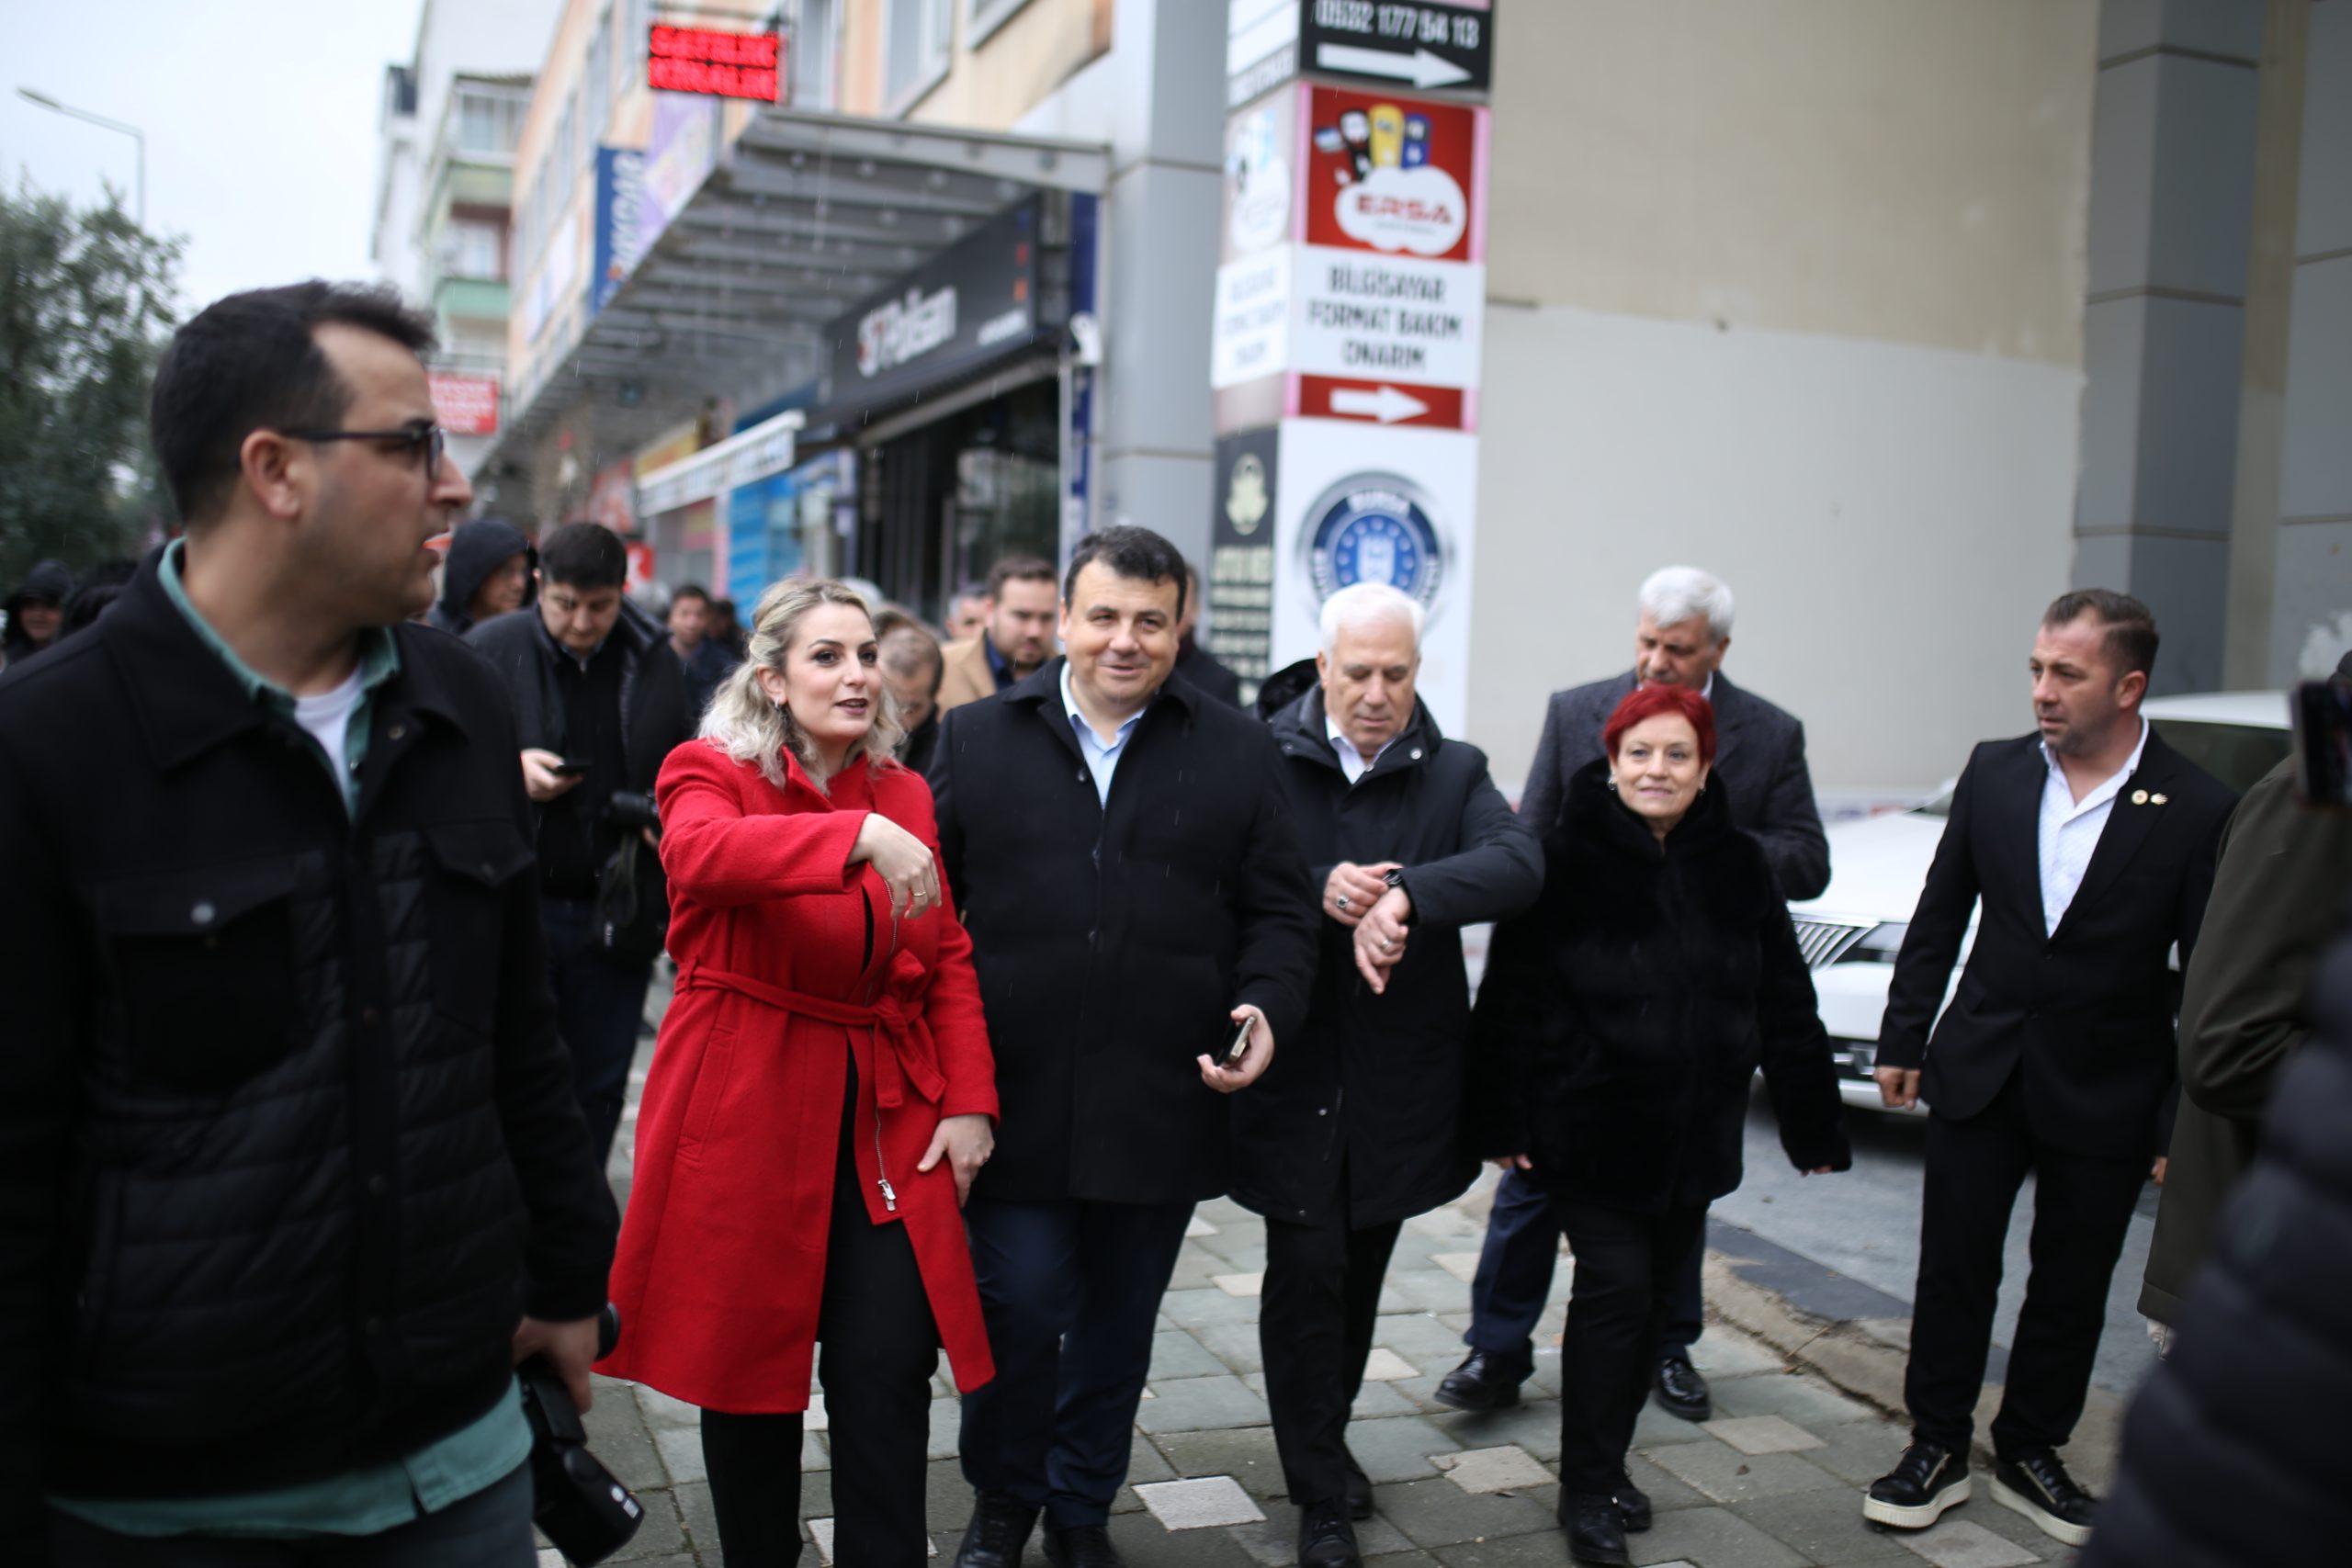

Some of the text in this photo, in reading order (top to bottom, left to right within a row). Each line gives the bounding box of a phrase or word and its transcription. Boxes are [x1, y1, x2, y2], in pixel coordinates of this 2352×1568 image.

[1356, 194, 1453, 226] ERSA
[1307, 298, 1392, 333] FORMAT
[1396, 309, 1463, 340] BAKIM
[1343, 337, 1426, 369] ONARIM
